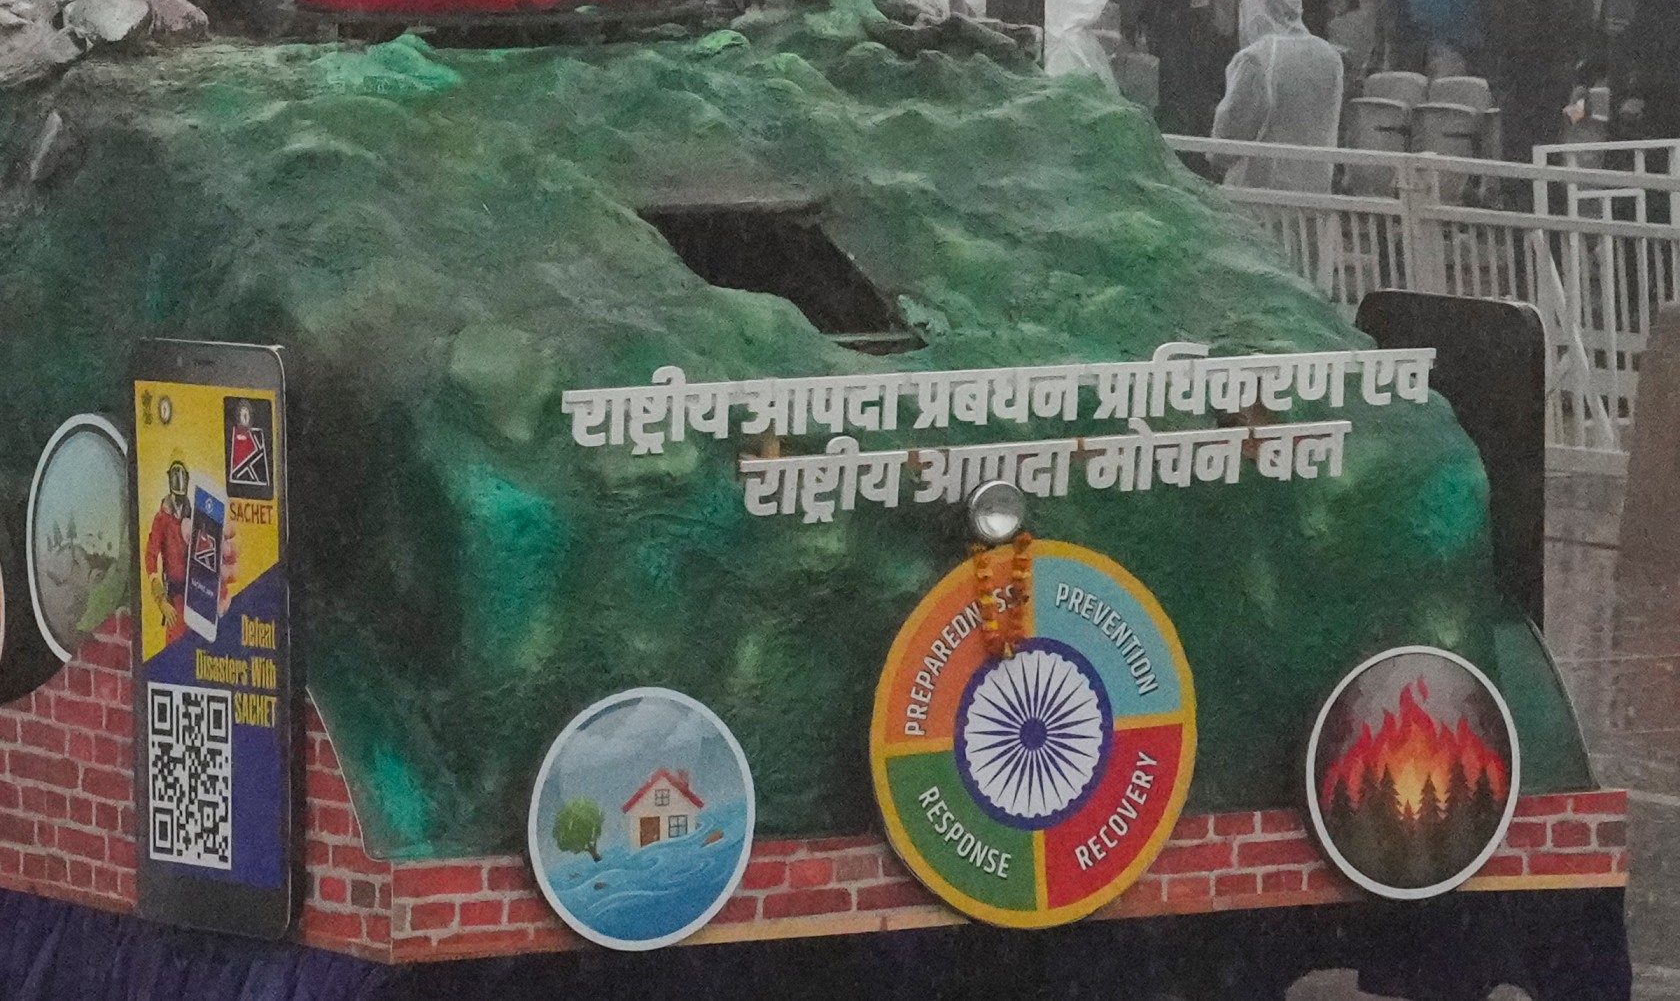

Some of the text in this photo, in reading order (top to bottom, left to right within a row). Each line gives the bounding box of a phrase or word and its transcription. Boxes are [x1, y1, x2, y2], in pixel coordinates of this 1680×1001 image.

[562, 365, 729, 455] राष्ट्रीय
[738, 373, 904, 436] आपदा
[1090, 341, 1349, 420] प्राधिकरण
[229, 501, 274, 525] SACHET
[740, 436, 908, 523] राष्ट्रीय
[1084, 418, 1249, 492] मोचन
[1253, 420, 1353, 481] बल
[195, 648, 277, 690] Disasters With
[241, 614, 276, 650] Defeat
[904, 583, 1016, 737] PREPAREDNSS
[1055, 582, 1159, 696] PREVENTION
[234, 690, 277, 728] SACHET
[918, 785, 1012, 879] RESPONSE
[1074, 751, 1159, 871] RECOVERY
